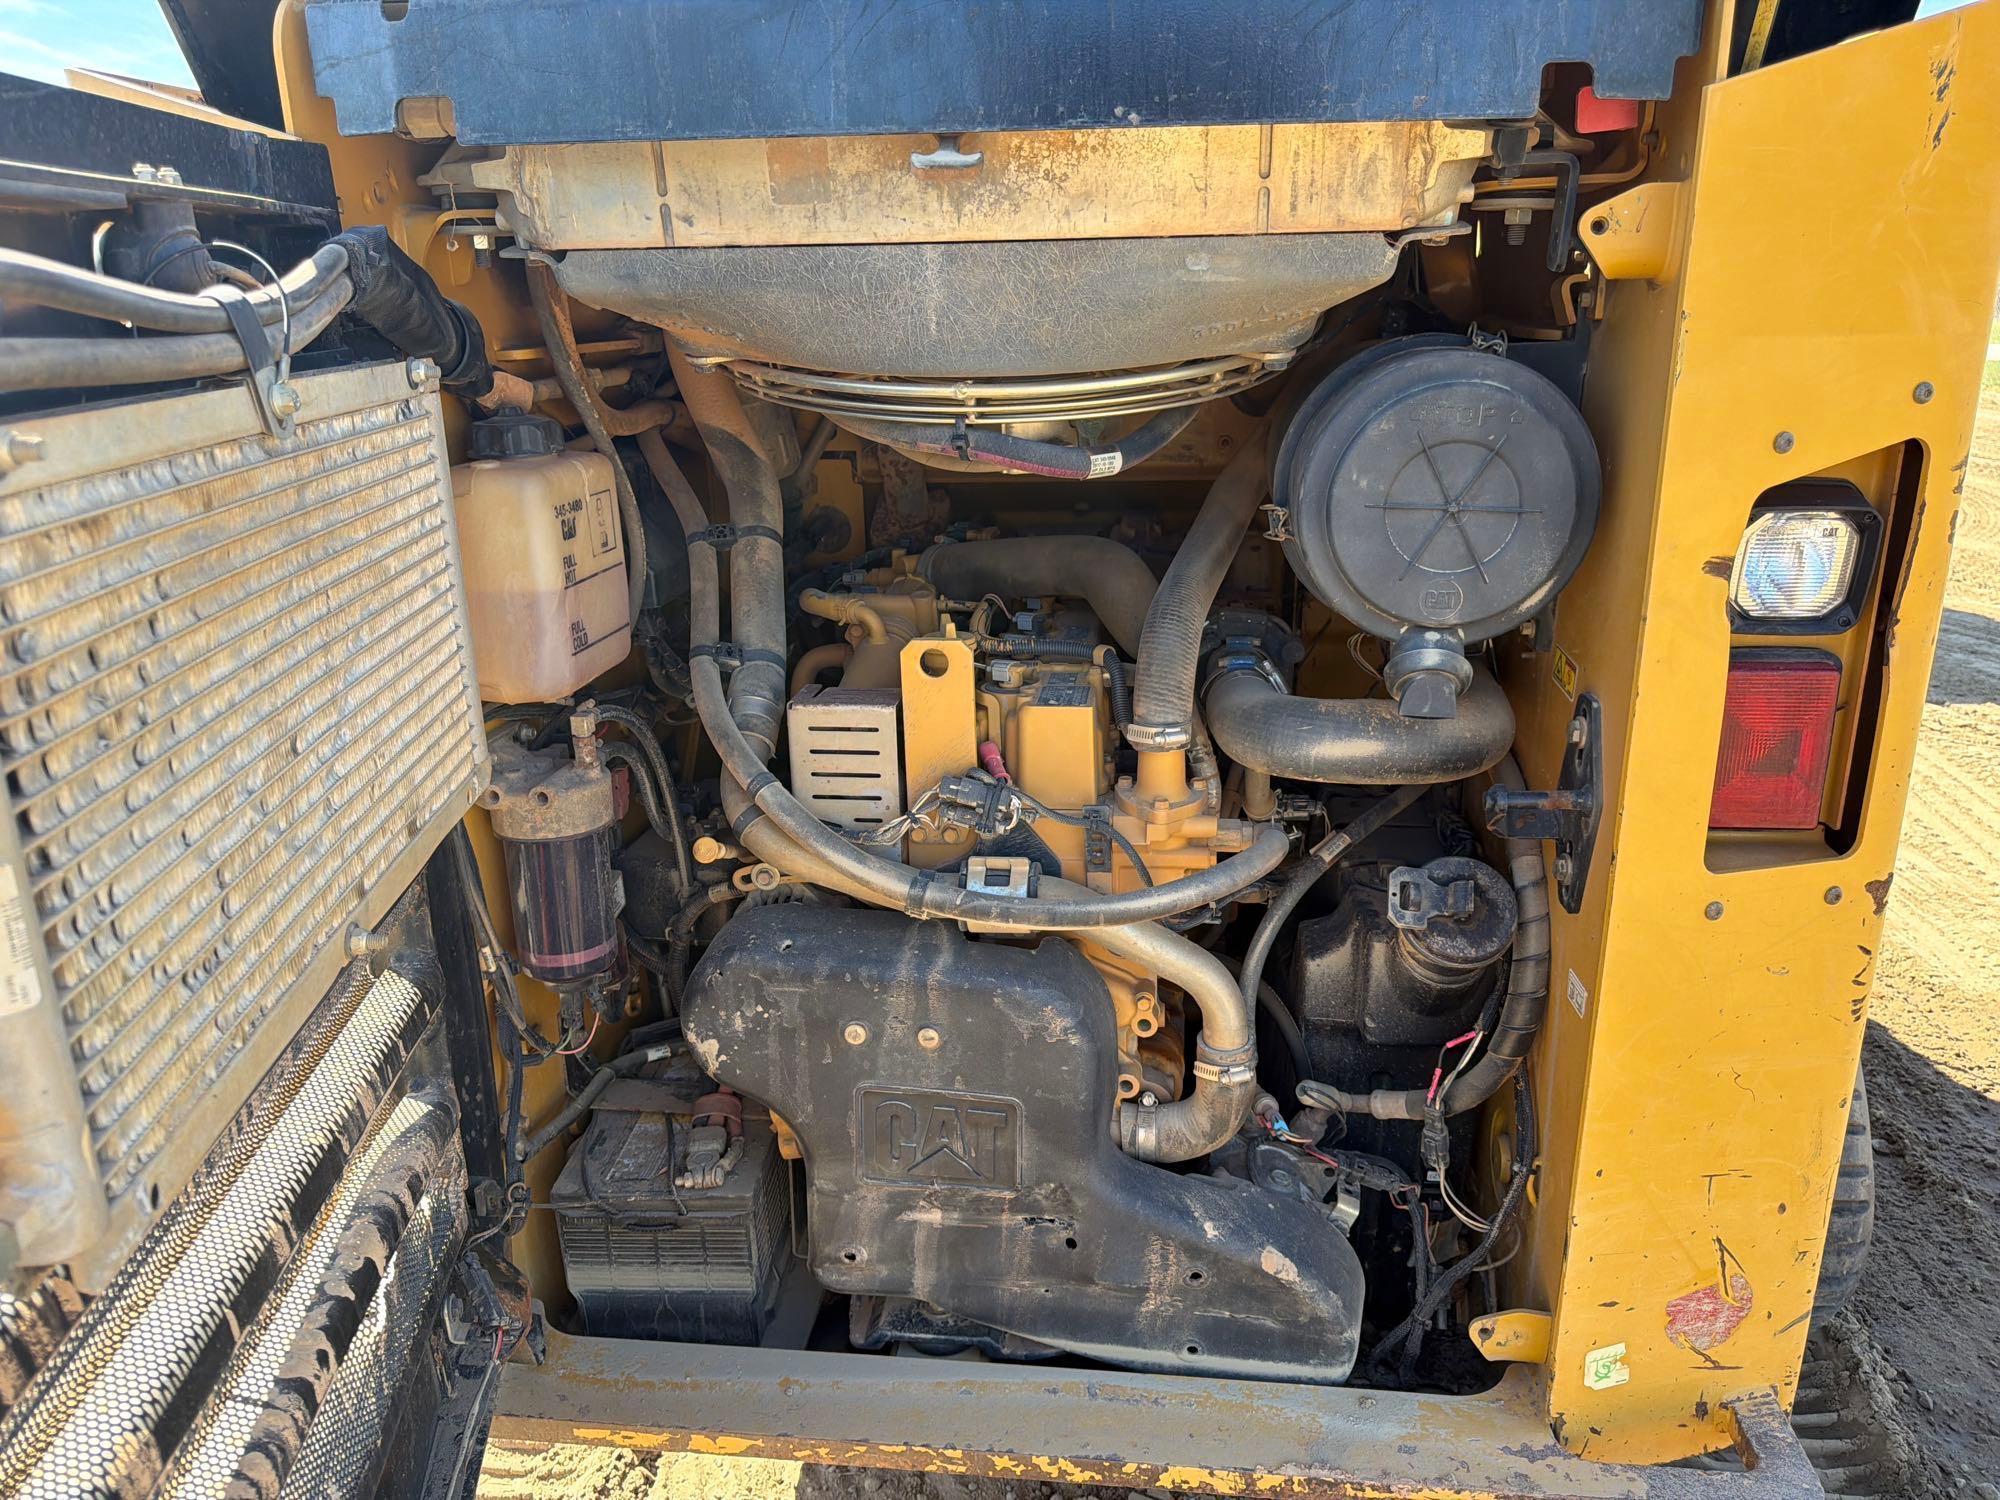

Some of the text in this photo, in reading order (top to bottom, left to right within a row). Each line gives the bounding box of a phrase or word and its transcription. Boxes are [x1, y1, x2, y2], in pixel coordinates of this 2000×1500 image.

[554, 499, 583, 519] 345-3480
[561, 516, 577, 541] CAT
[1822, 527, 1839, 537] CAT
[563, 554, 578, 569] FULL
[565, 569, 577, 585] HOT
[1424, 590, 1458, 610] CAT
[571, 618, 586, 637] FULL
[573, 632, 588, 651] COLD
[875, 1100, 1008, 1184] CAT
